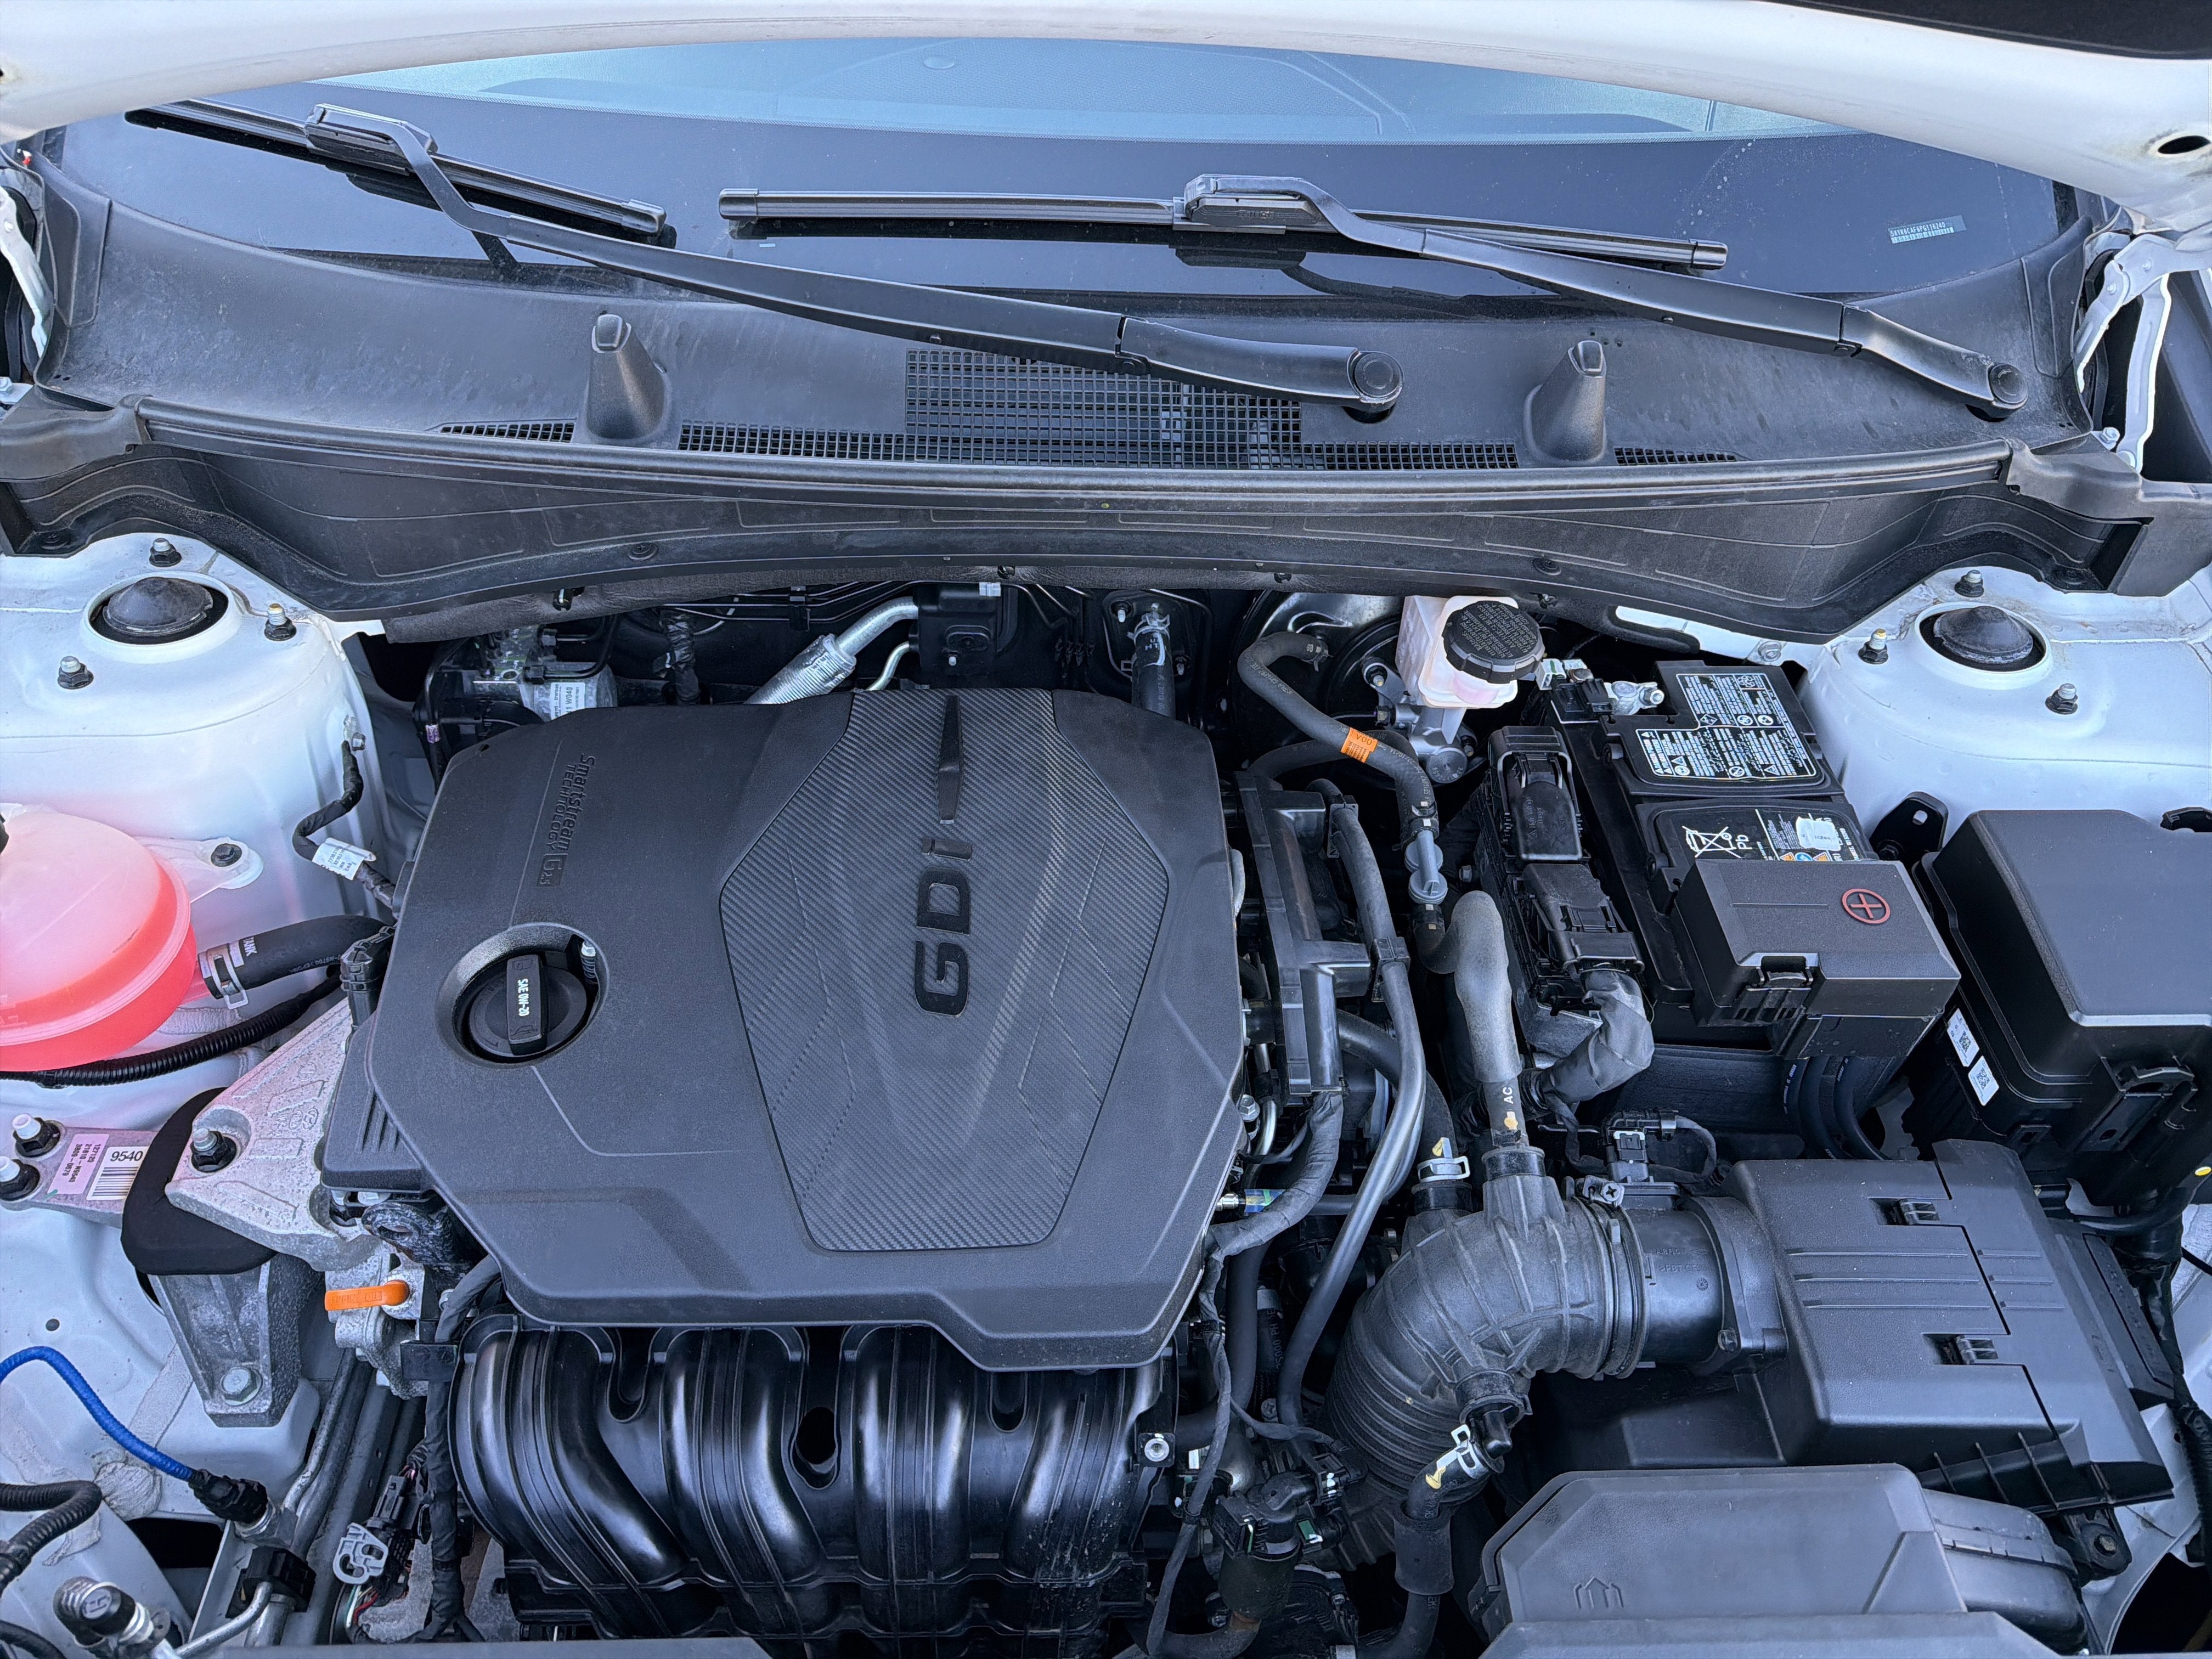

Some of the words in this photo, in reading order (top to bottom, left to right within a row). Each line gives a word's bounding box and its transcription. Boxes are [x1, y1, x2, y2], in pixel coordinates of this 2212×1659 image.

[546, 764, 576, 850] TECHNOLOGY
[557, 754, 595, 850] Smartstream
[1736, 834, 1753, 850] Pb
[242, 936, 257, 957] TANK
[517, 978, 528, 993] SAE
[518, 994, 529, 1017] 0W-20
[1502, 1086, 1514, 1104] AC
[87, 1143, 101, 1163] 127120
[110, 1151, 143, 1162] 9540
